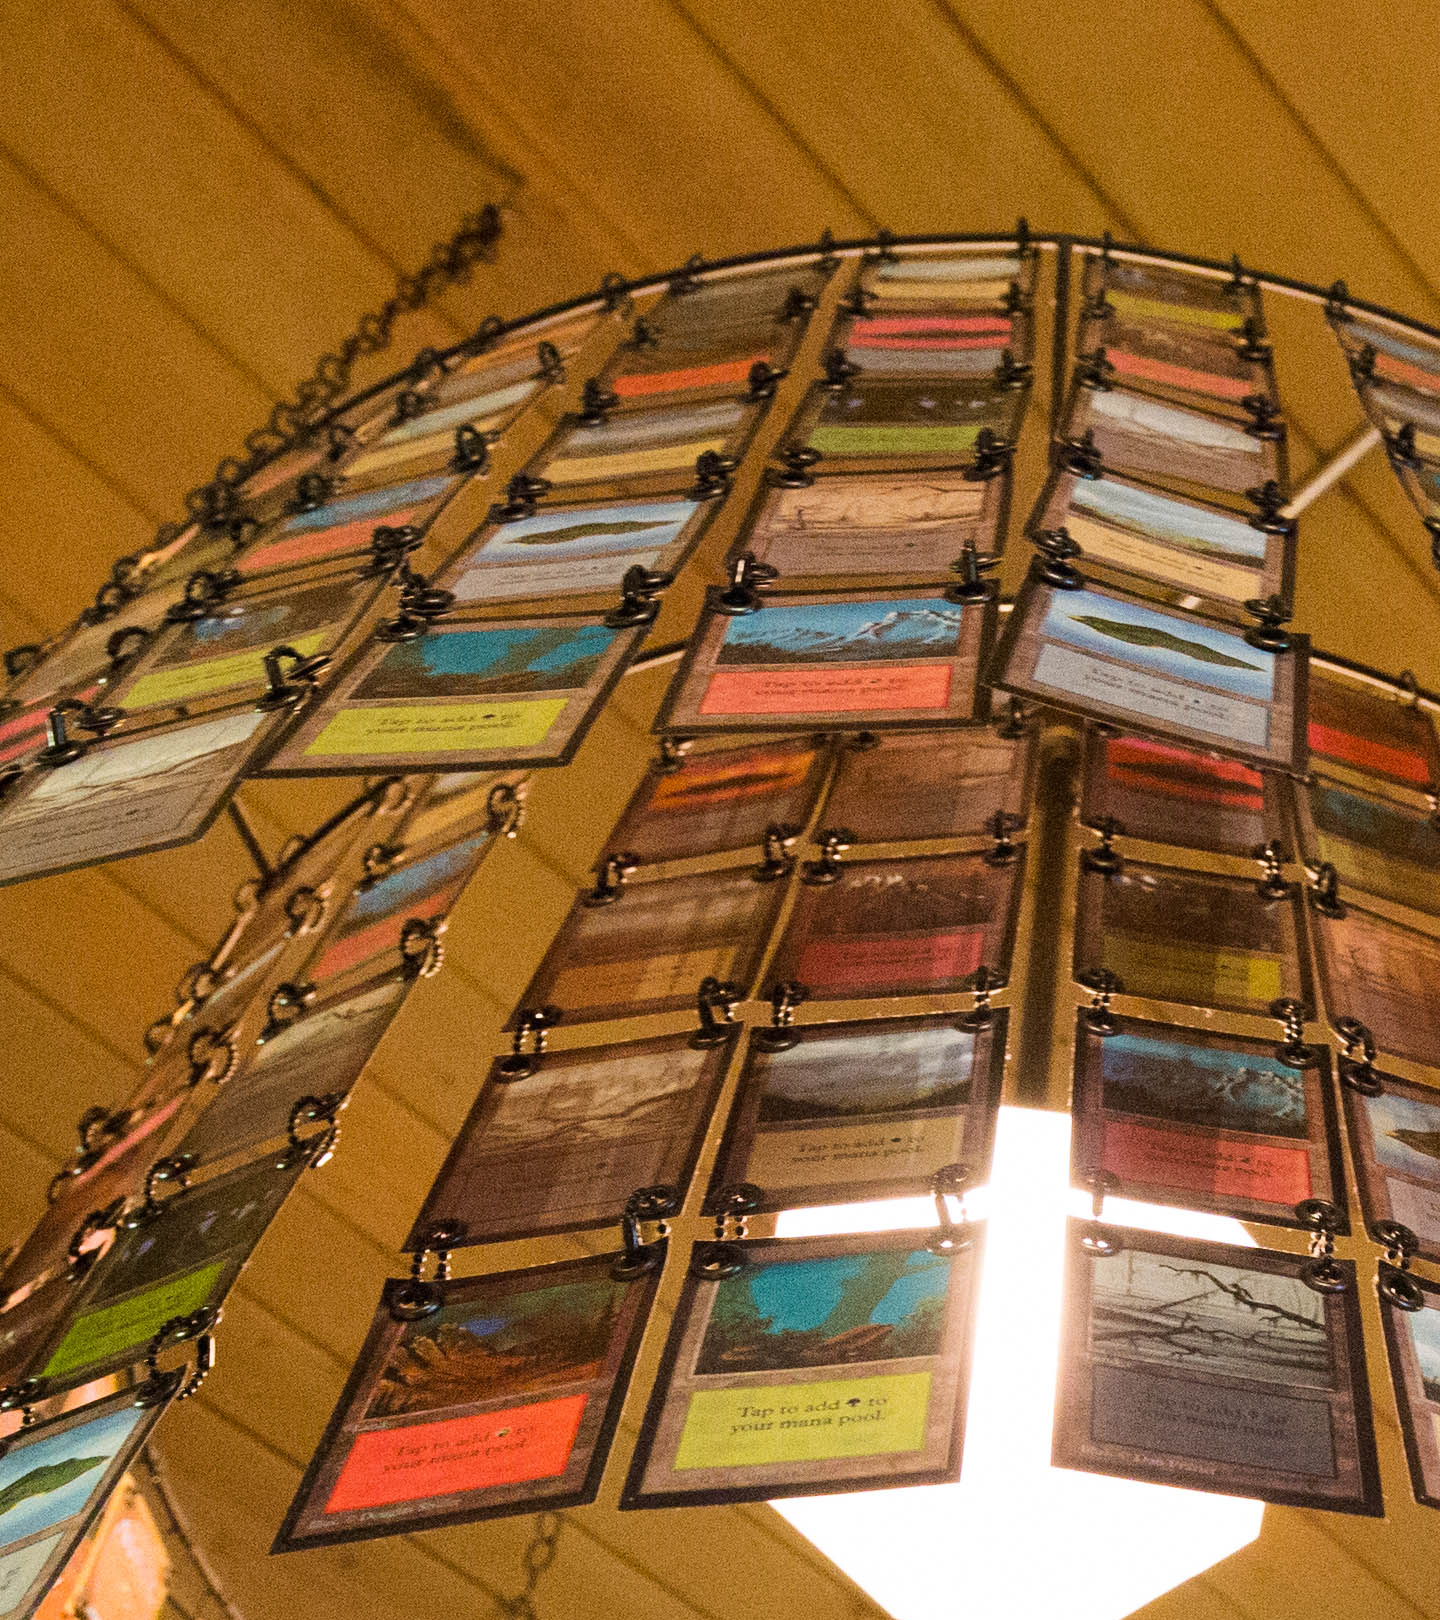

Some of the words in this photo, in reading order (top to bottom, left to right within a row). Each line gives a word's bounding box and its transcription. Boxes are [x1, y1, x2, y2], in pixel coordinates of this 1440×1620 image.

[738, 1406, 774, 1419] Tap
[780, 1406, 799, 1415] to
[804, 1400, 841, 1412] add
[868, 1397, 888, 1407] to
[730, 1421, 775, 1436] your
[779, 1418, 832, 1430] mana
